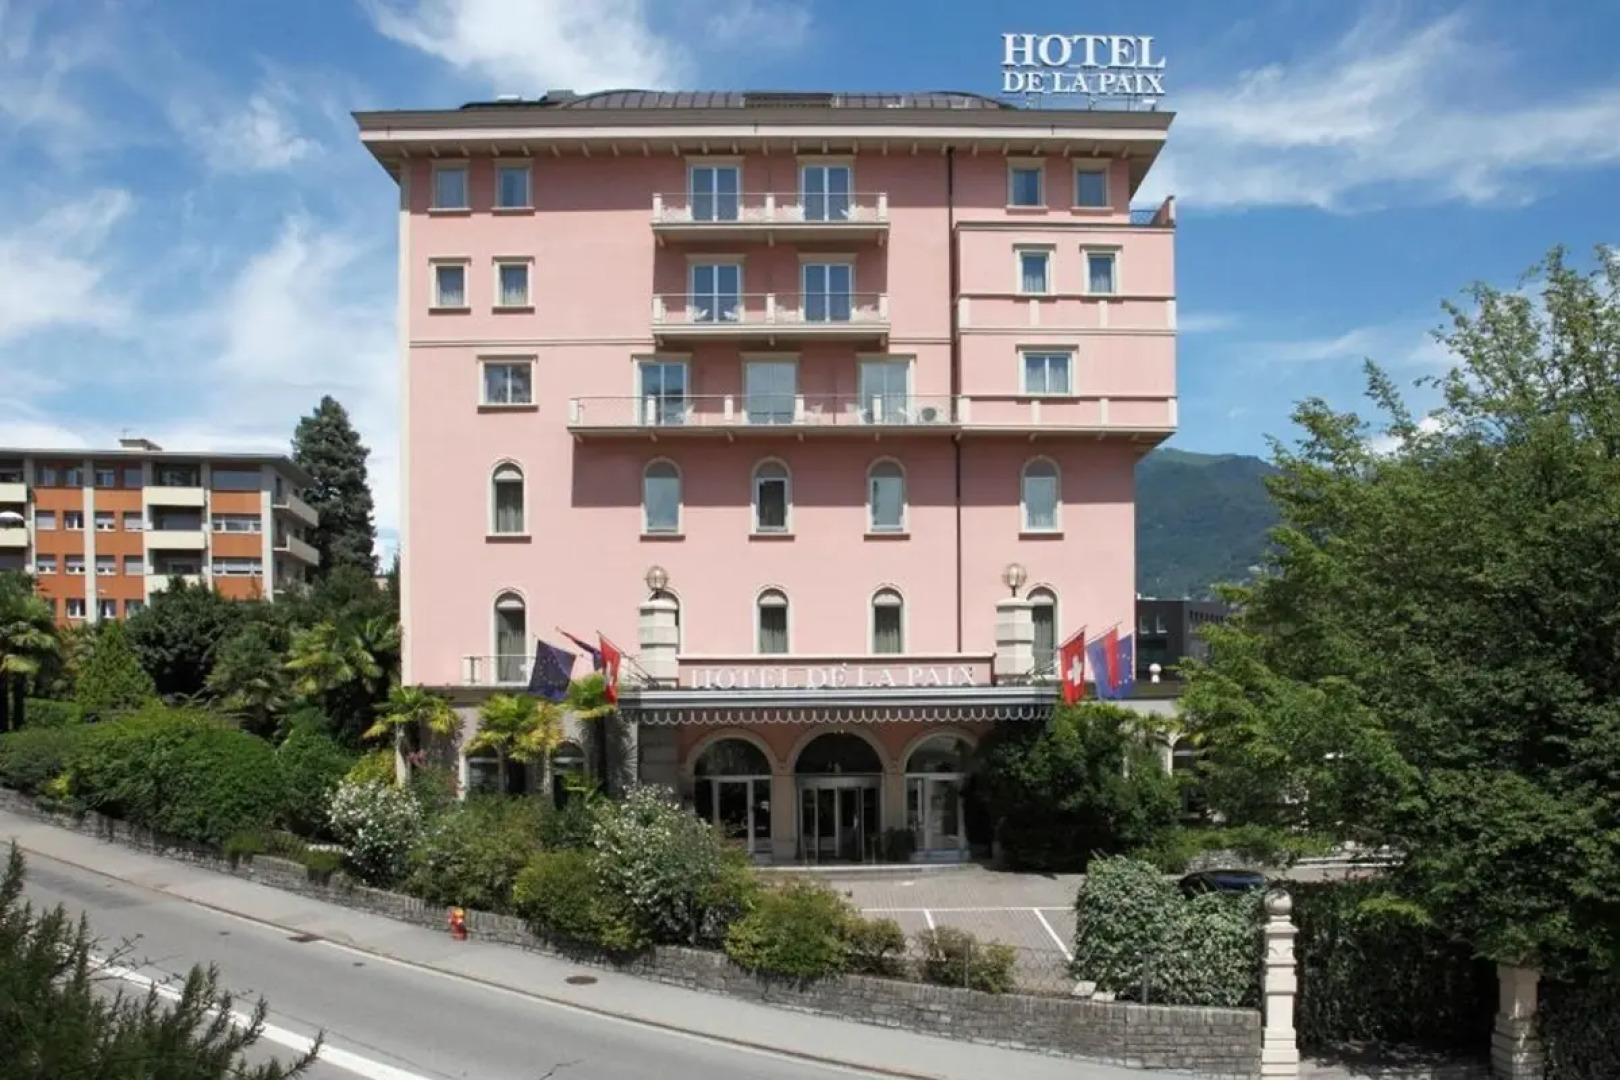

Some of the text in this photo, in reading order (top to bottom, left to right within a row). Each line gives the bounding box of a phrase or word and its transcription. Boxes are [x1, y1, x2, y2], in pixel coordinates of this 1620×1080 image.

[1001, 33, 1166, 68] HOTEL
[1002, 71, 1166, 95] DE LA PAIX
[691, 667, 800, 688] HOTEL
[857, 666, 896, 687] LA
[907, 665, 975, 686] PAIX
